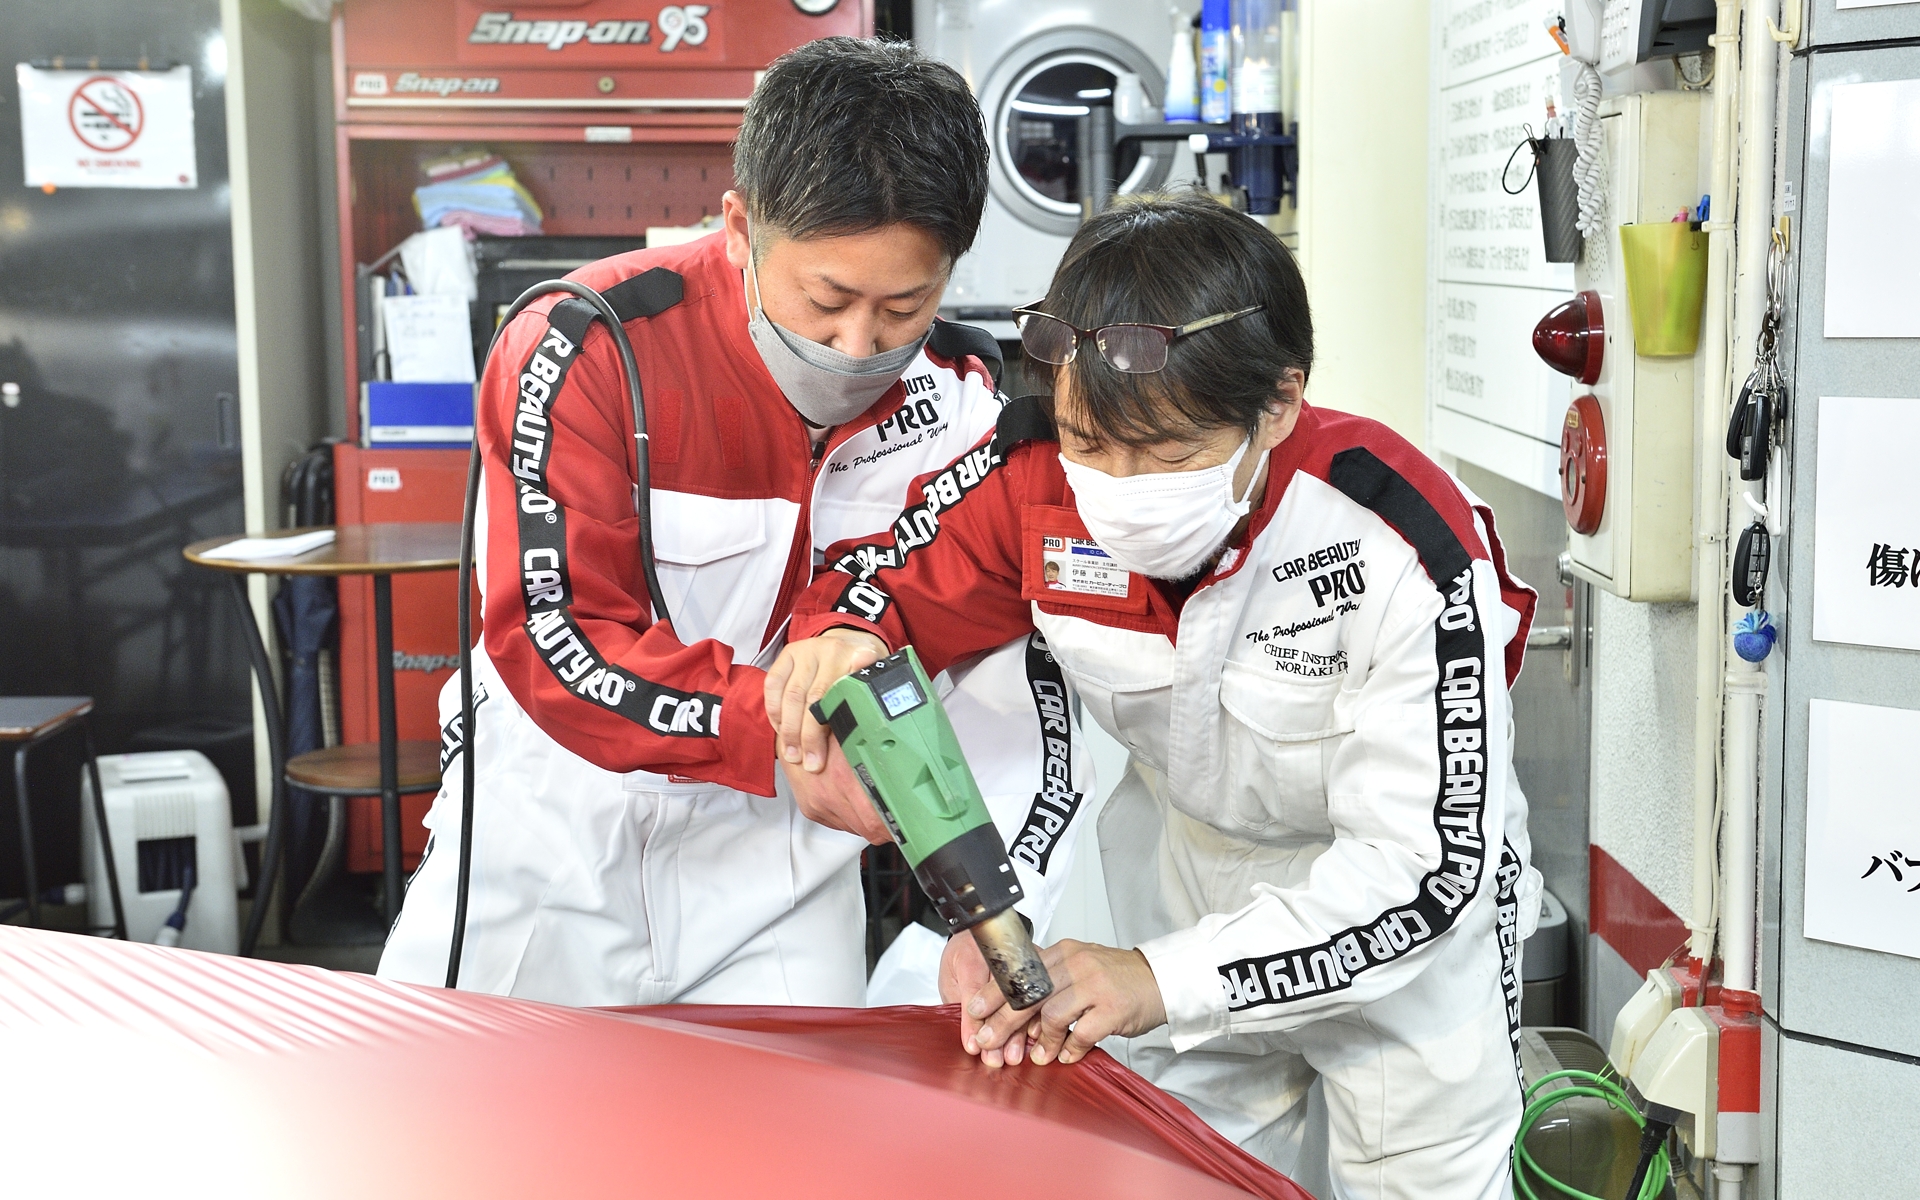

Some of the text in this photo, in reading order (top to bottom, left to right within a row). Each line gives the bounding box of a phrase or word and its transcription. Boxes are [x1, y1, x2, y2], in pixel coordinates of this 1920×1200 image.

[467, 5, 711, 52] Snap-on 95
[394, 72, 501, 97] Snap-on
[513, 352, 561, 482] BEAUTY
[829, 422, 949, 474] The Professional Way
[1043, 538, 1061, 548] PRO
[1272, 539, 1361, 582] CAR BEAUTY
[523, 548, 564, 606] CAR
[1246, 630, 1270, 644] The
[1272, 610, 1334, 639] Professional
[1264, 643, 1299, 660] CHIEF
[1275, 661, 1334, 676] NORIAKI
[1440, 656, 1482, 725] CAR
[1032, 679, 1068, 735] CAR
[1439, 728, 1483, 850] BEAUTY
[1013, 806, 1065, 872] PRO
[1360, 909, 1432, 961] CAR
